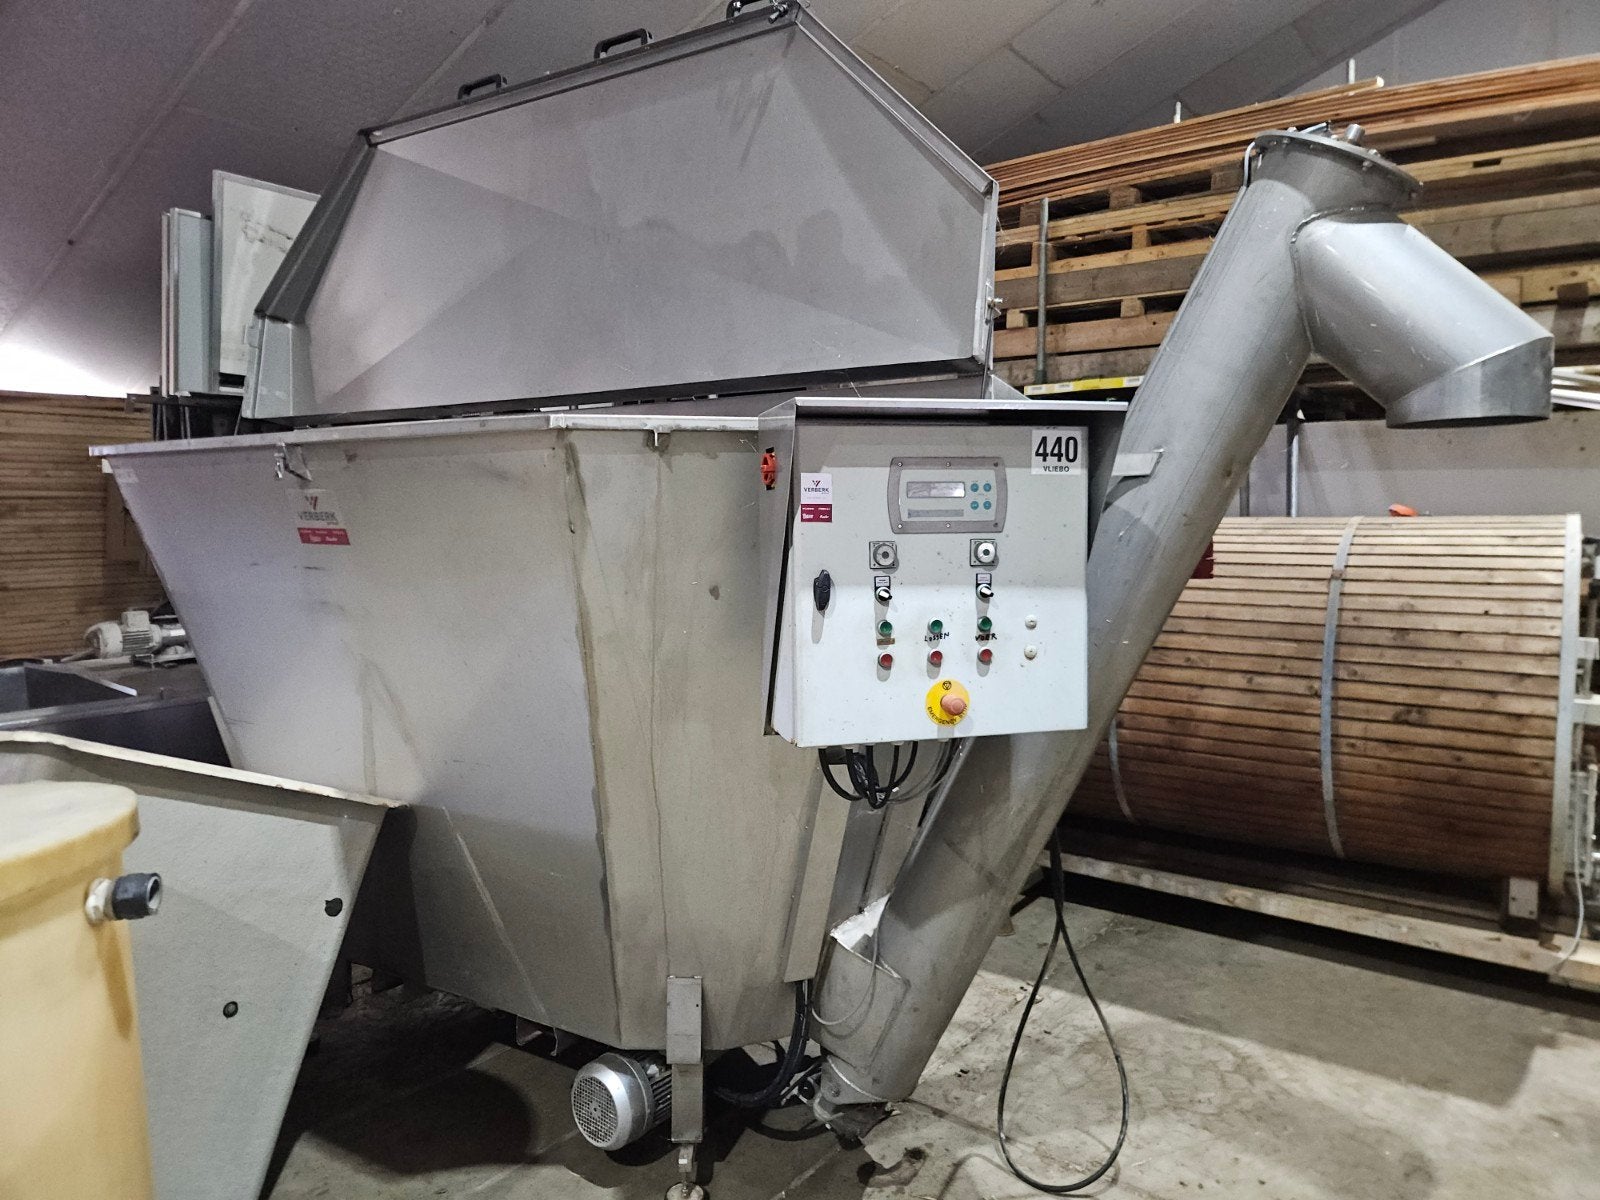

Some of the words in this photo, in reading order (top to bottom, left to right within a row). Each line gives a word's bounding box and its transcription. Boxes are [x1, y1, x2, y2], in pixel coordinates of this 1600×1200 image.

[1034, 436, 1078, 463] 440
[1043, 465, 1070, 473] VLIEBO
[297, 511, 338, 522] VERBERK
